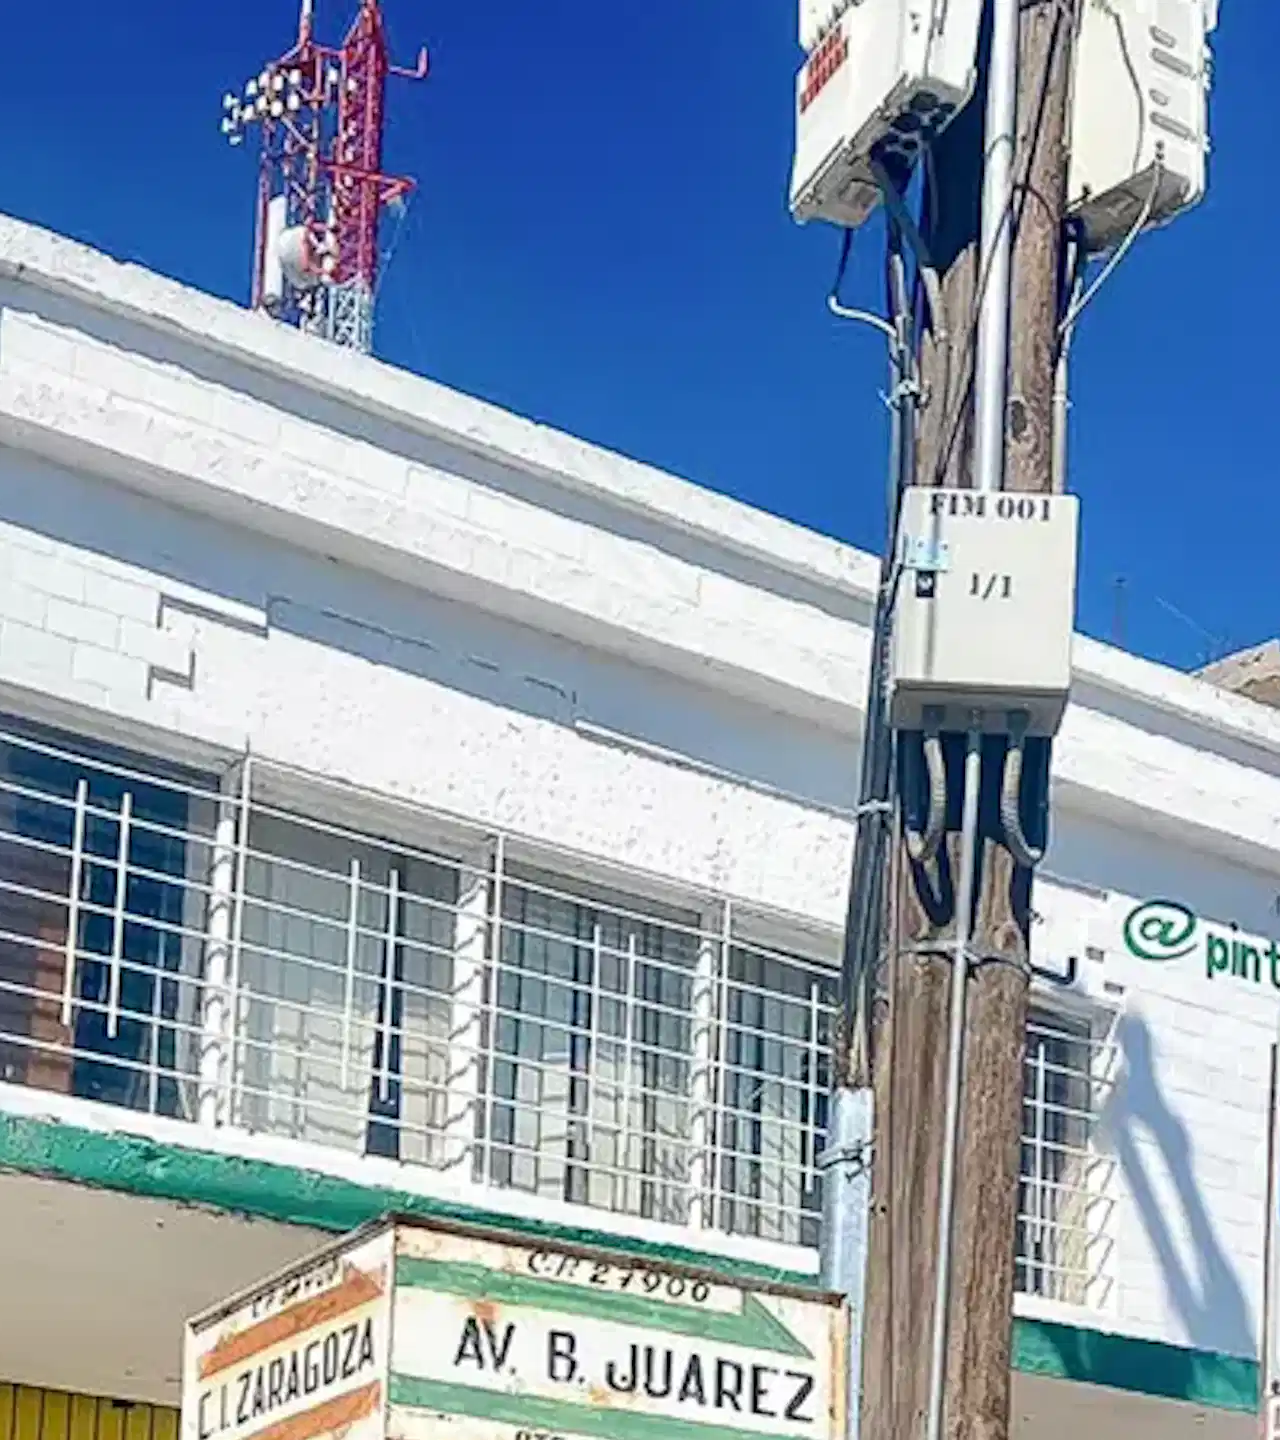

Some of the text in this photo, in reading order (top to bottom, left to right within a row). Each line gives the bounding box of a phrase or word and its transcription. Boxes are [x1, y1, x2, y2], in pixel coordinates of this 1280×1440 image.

[928, 492, 1052, 522] FIM 001
[969, 572, 1013, 599] 1/1
[453, 1316, 815, 1424] AV. B. JUAREZ
